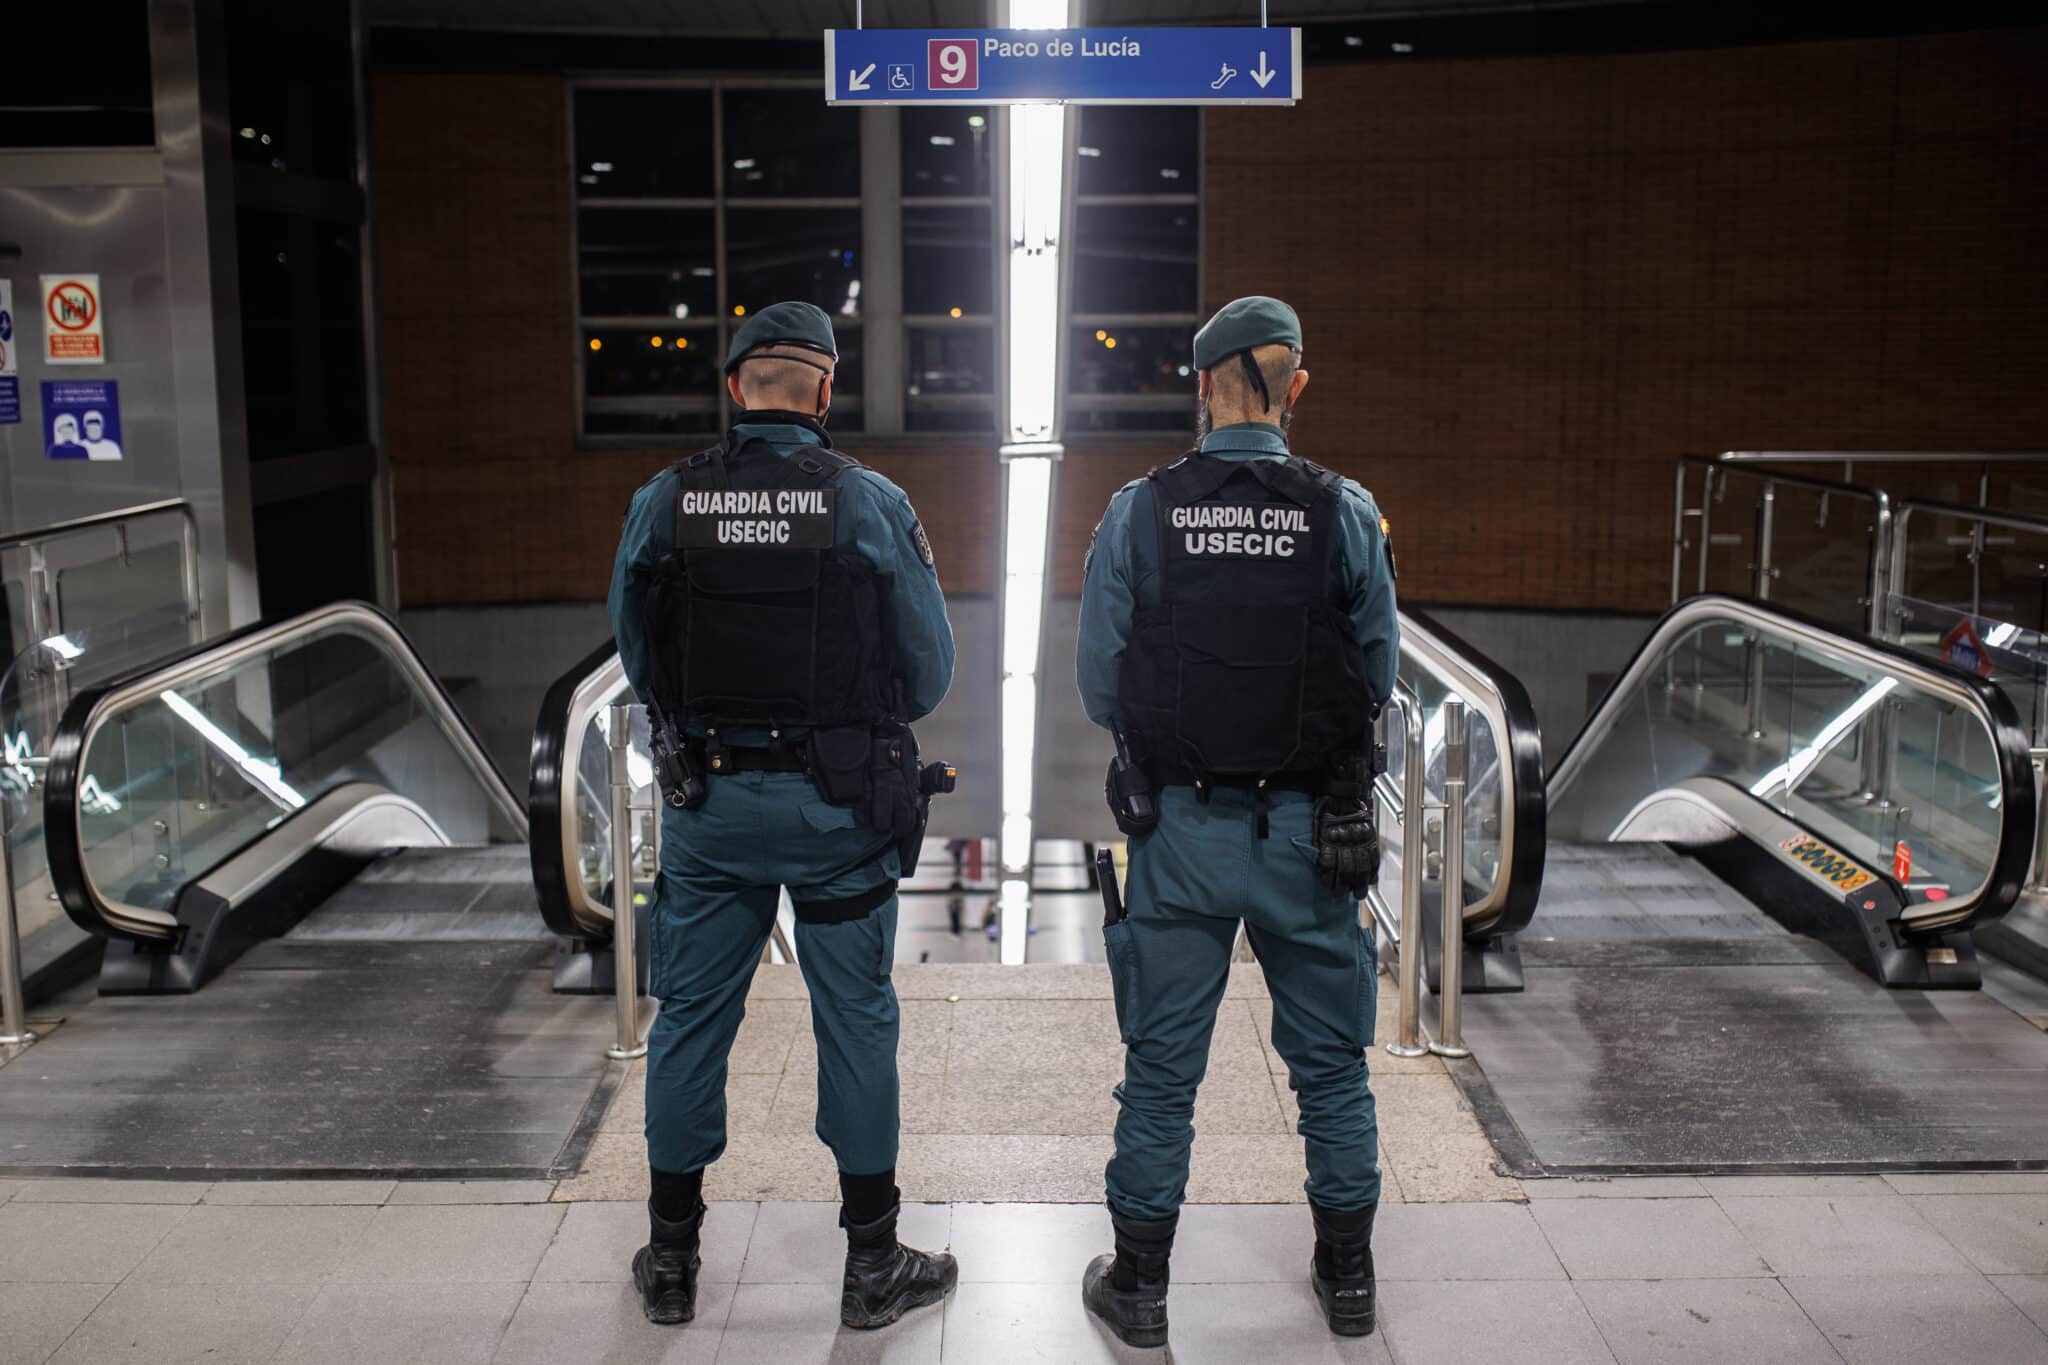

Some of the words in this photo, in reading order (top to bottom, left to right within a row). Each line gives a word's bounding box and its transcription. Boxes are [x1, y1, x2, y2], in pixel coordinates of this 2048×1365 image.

[984, 38, 1039, 57] Paco
[1046, 38, 1073, 57] de
[1081, 36, 1140, 57] Lucía
[939, 45, 967, 84] 9
[682, 491, 772, 515] GUARDIA
[776, 491, 827, 514] CIVIL
[1171, 506, 1256, 529] GUARDIA
[1260, 508, 1310, 533] CIVIL
[717, 520, 791, 544] USECIC
[1185, 532, 1295, 557] USECIC
